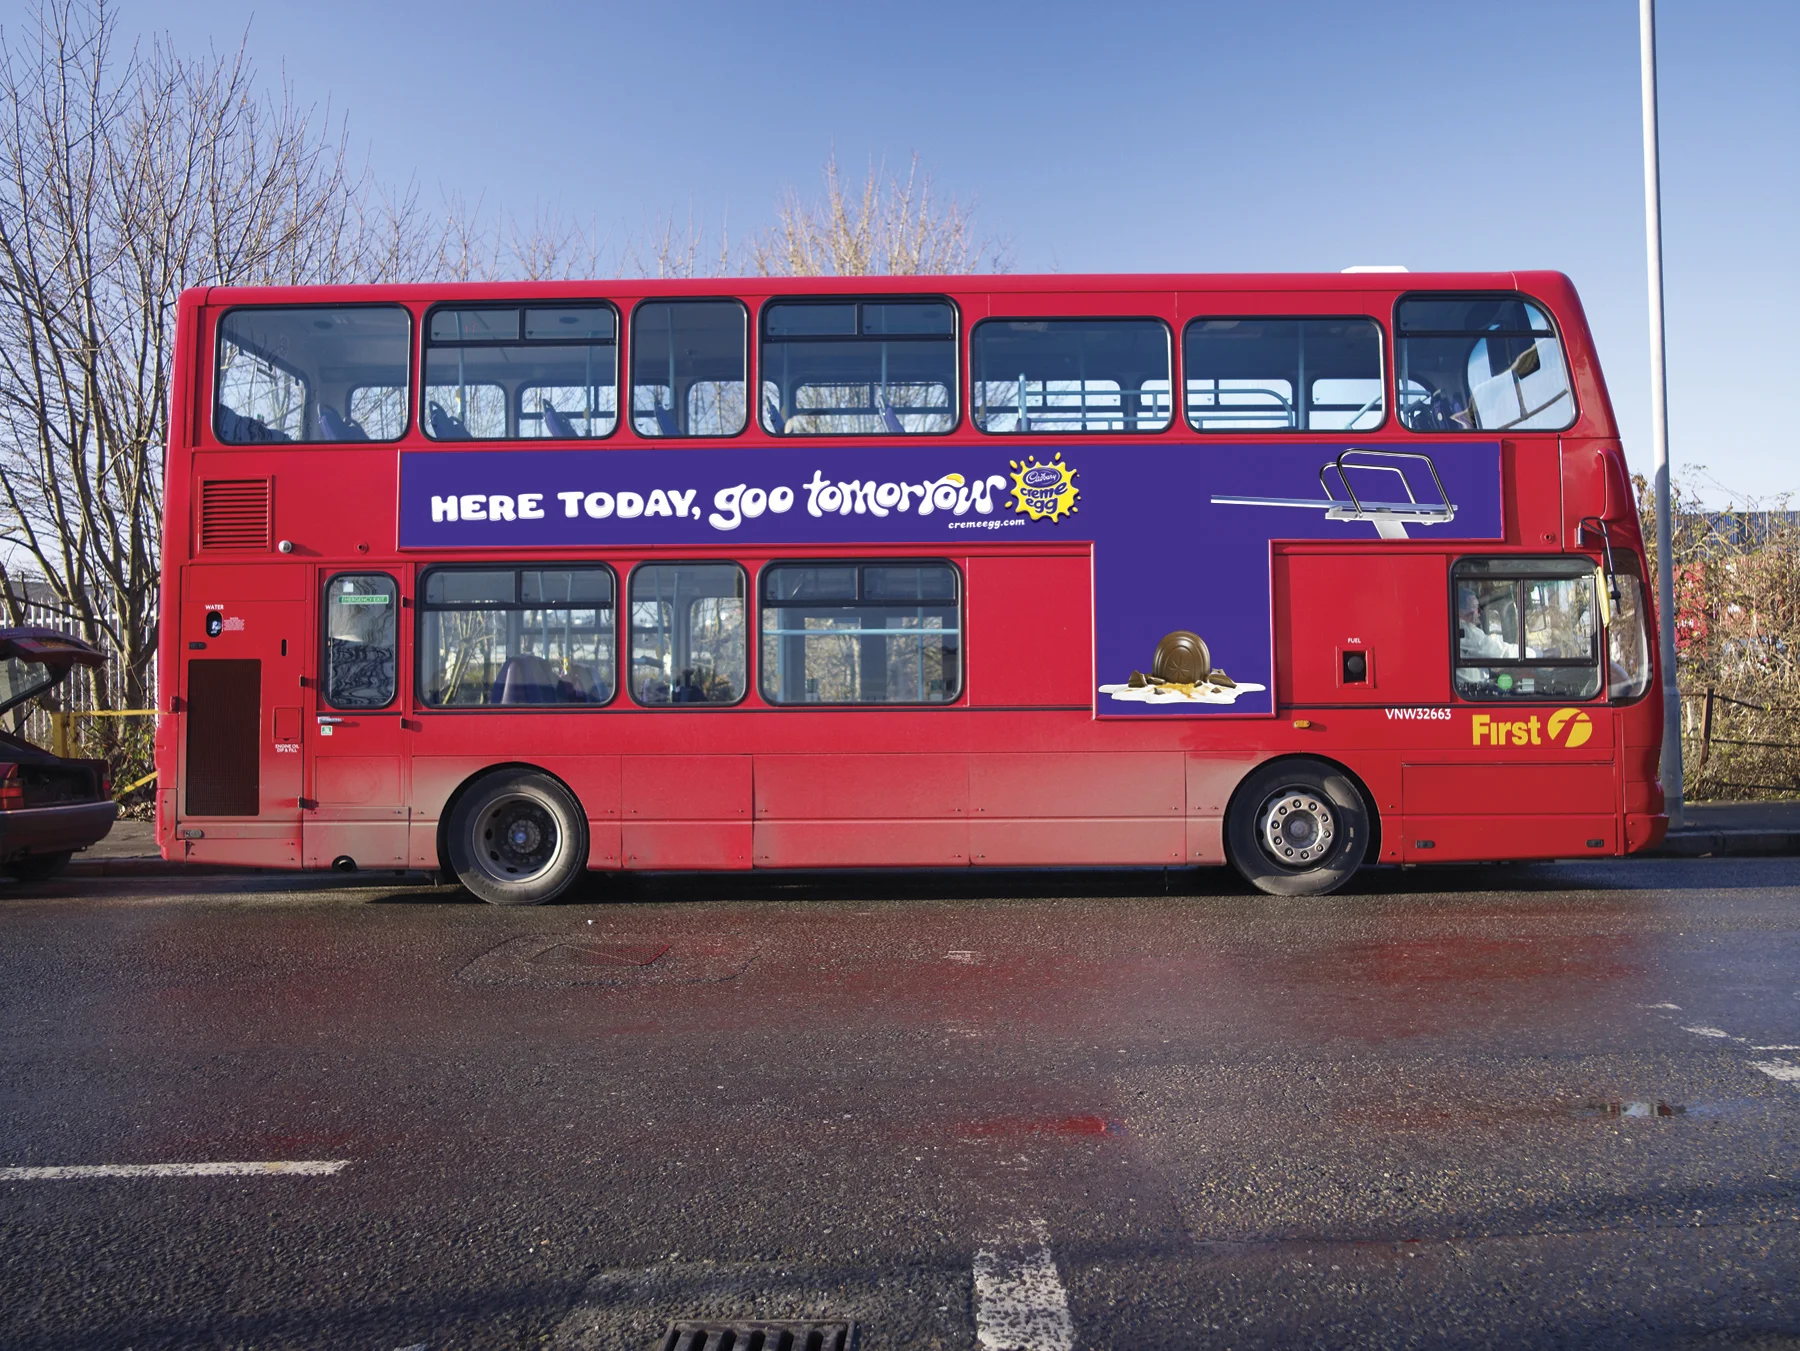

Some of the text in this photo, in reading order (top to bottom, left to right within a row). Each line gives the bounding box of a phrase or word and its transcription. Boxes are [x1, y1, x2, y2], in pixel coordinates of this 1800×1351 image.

[1020, 482, 1068, 499] creme
[431, 470, 1007, 531] HERE TODAY, goo tomorrow
[1025, 498, 1058, 515] egg
[948, 518, 1025, 529] cremeegg.com
[1385, 708, 1451, 720] VNW32663
[1472, 714, 1541, 746] First
